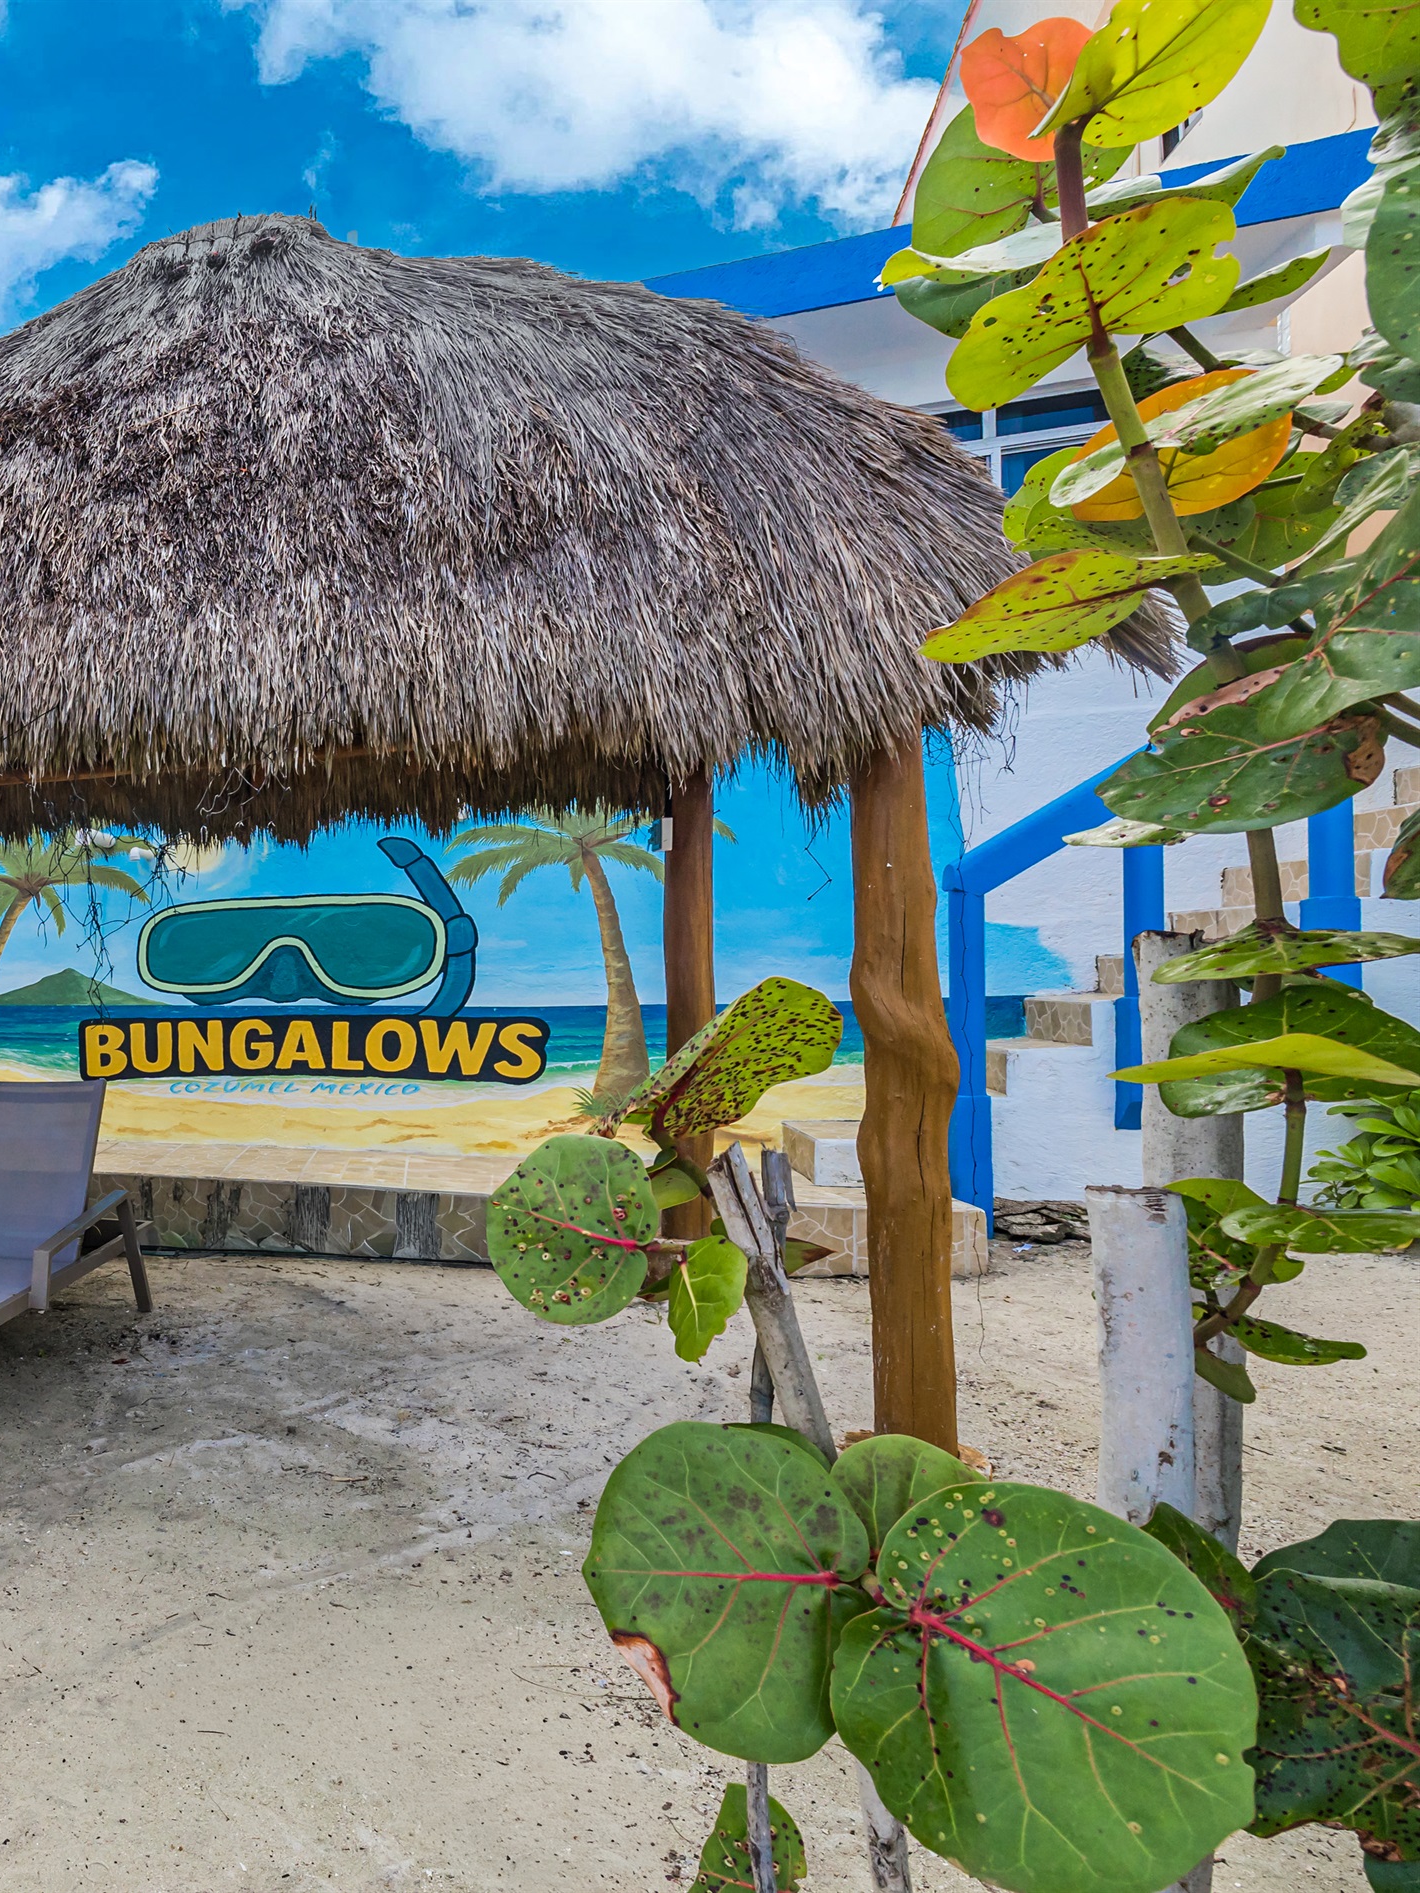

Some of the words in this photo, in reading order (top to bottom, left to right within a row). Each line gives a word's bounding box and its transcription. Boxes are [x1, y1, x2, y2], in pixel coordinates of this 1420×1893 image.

[85, 1019, 543, 1078] BUNGALOWS
[169, 1080, 300, 1095] COZUMEL
[310, 1081, 421, 1097] MEXICO
